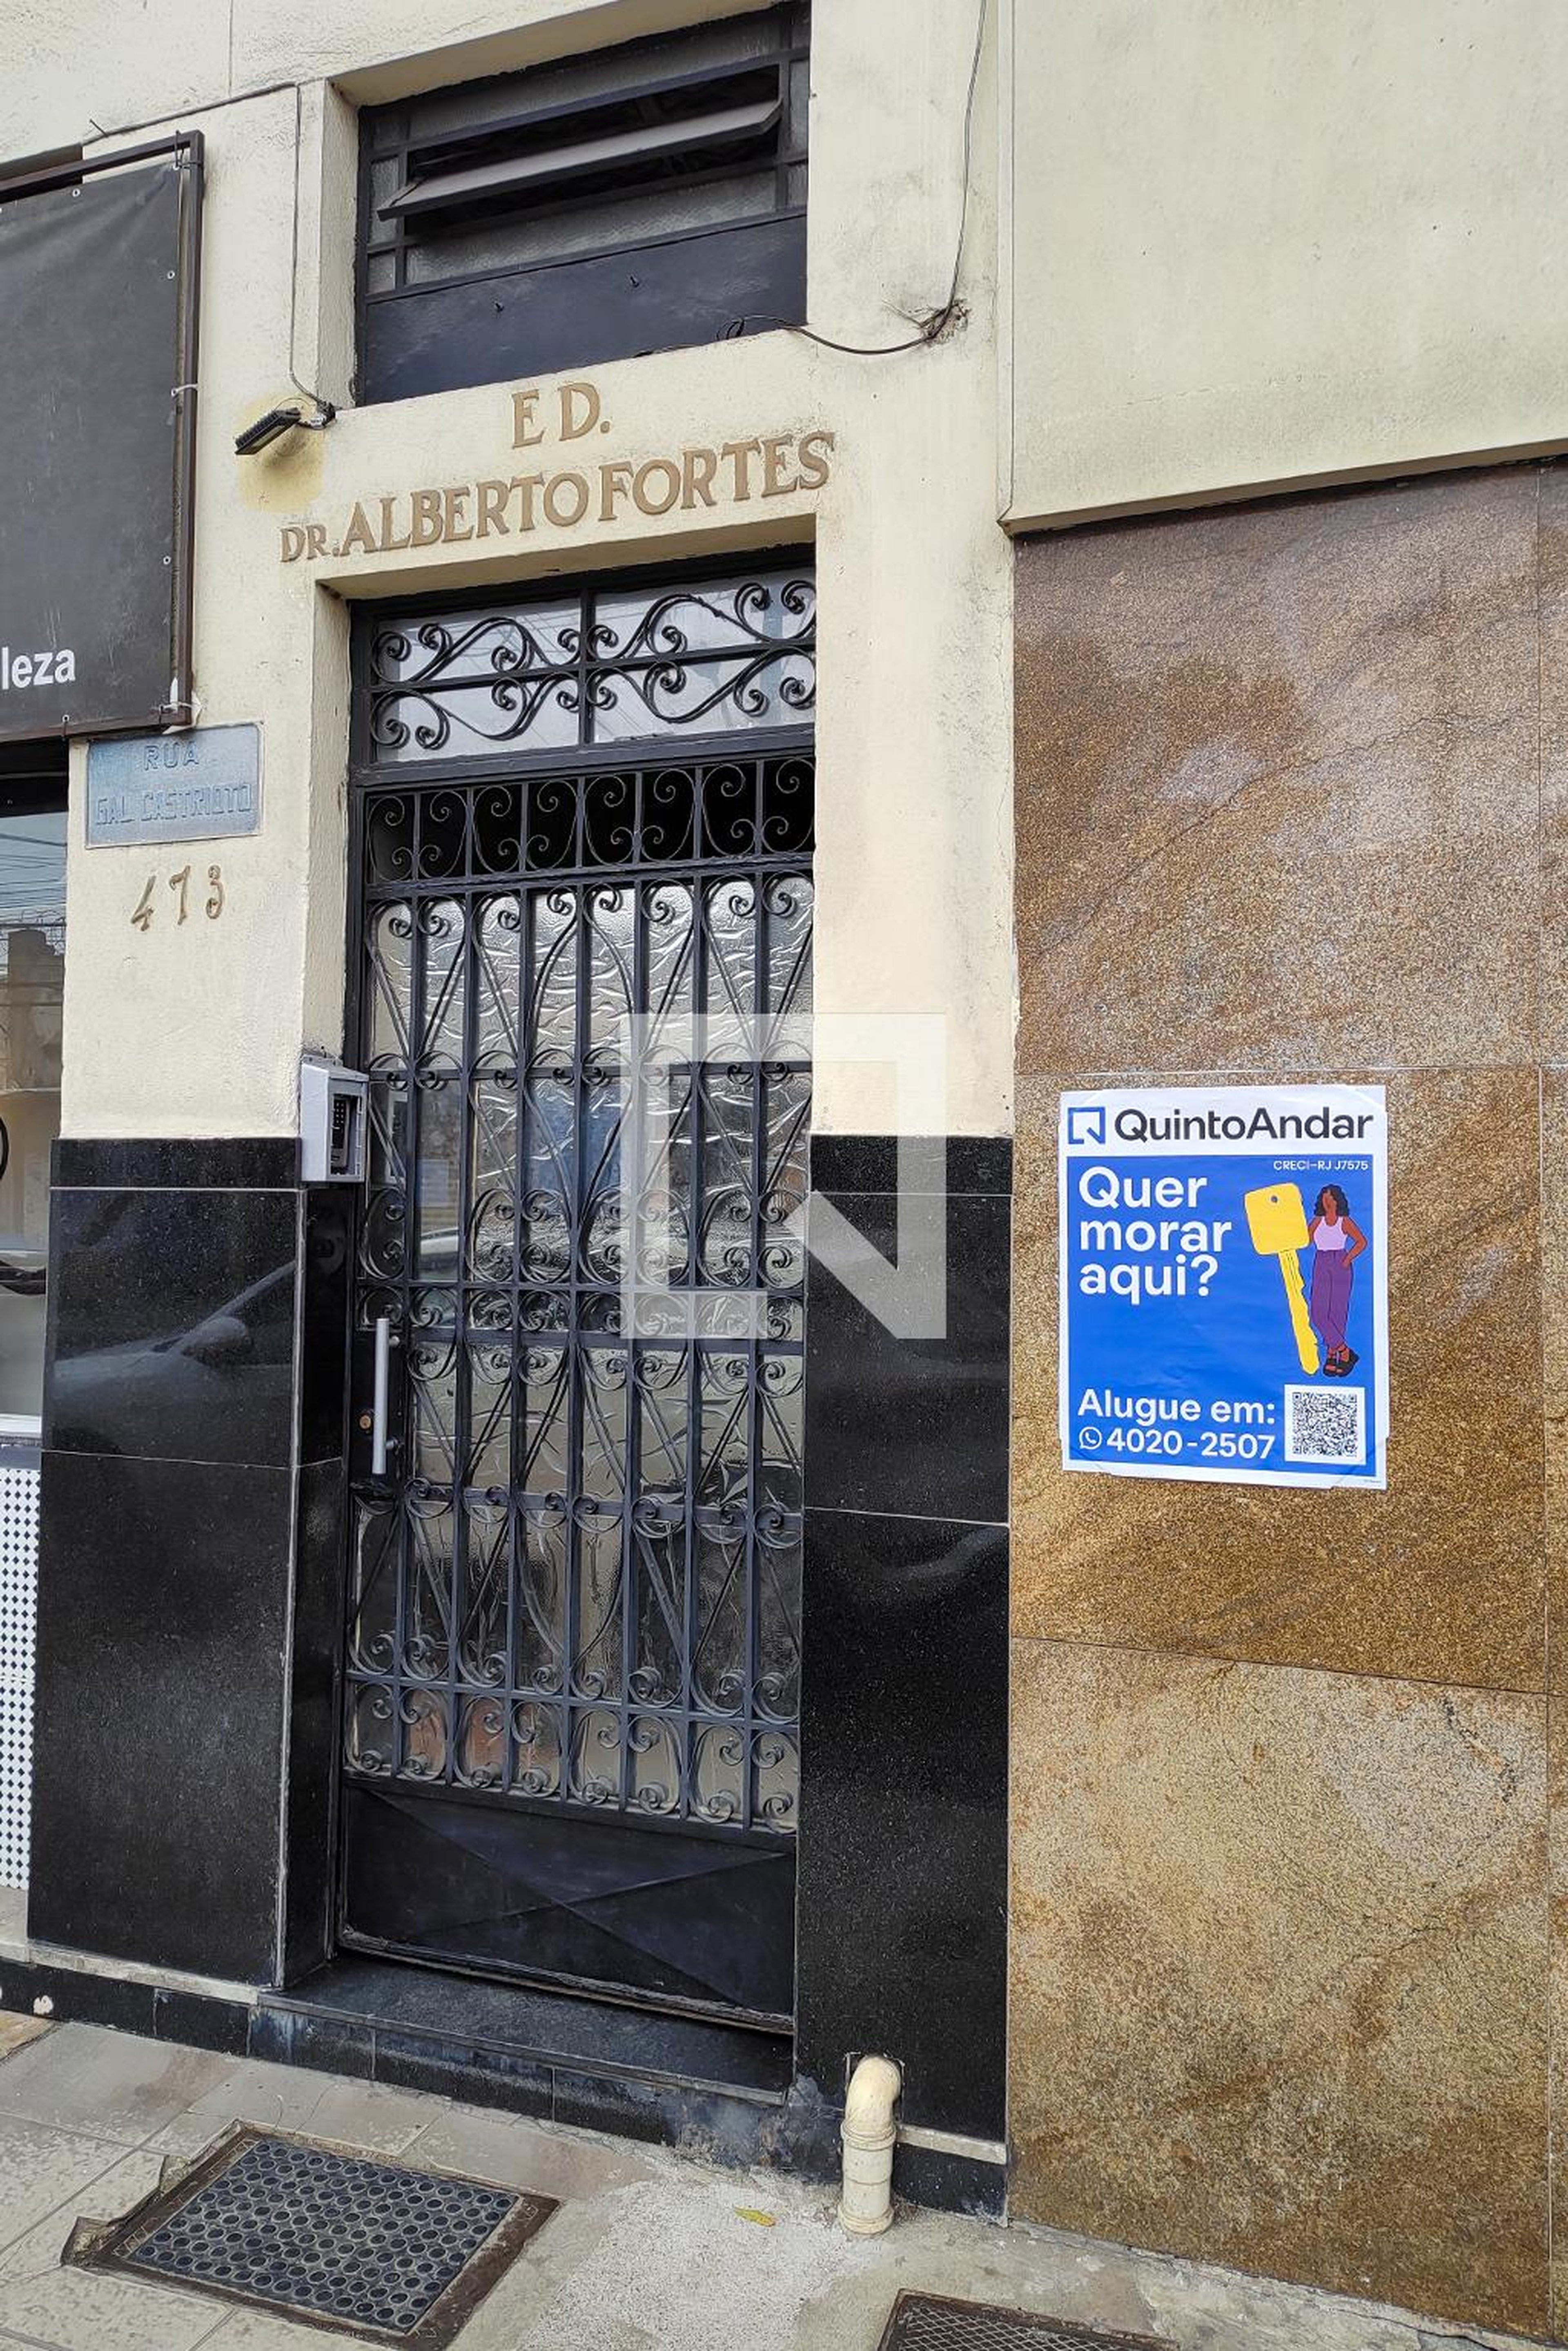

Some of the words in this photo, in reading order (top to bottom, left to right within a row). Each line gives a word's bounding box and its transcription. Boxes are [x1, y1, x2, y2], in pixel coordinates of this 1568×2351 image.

[512, 381, 612, 448] ED.
[340, 472, 590, 556] ALBERTO
[598, 430, 835, 522] FORTES
[2, 646, 76, 690] leza
[144, 741, 199, 771] RUA
[1114, 1107, 1374, 1142] QuintoAndar
[1334, 1160, 1368, 1170] J7575
[1079, 1167, 1207, 1209] Quer
[1080, 1219, 1232, 1252] morar
[1079, 1254, 1218, 1305] aqui?
[1078, 1389, 1201, 1426] Alugue
[1210, 1399, 1275, 1424] em:
